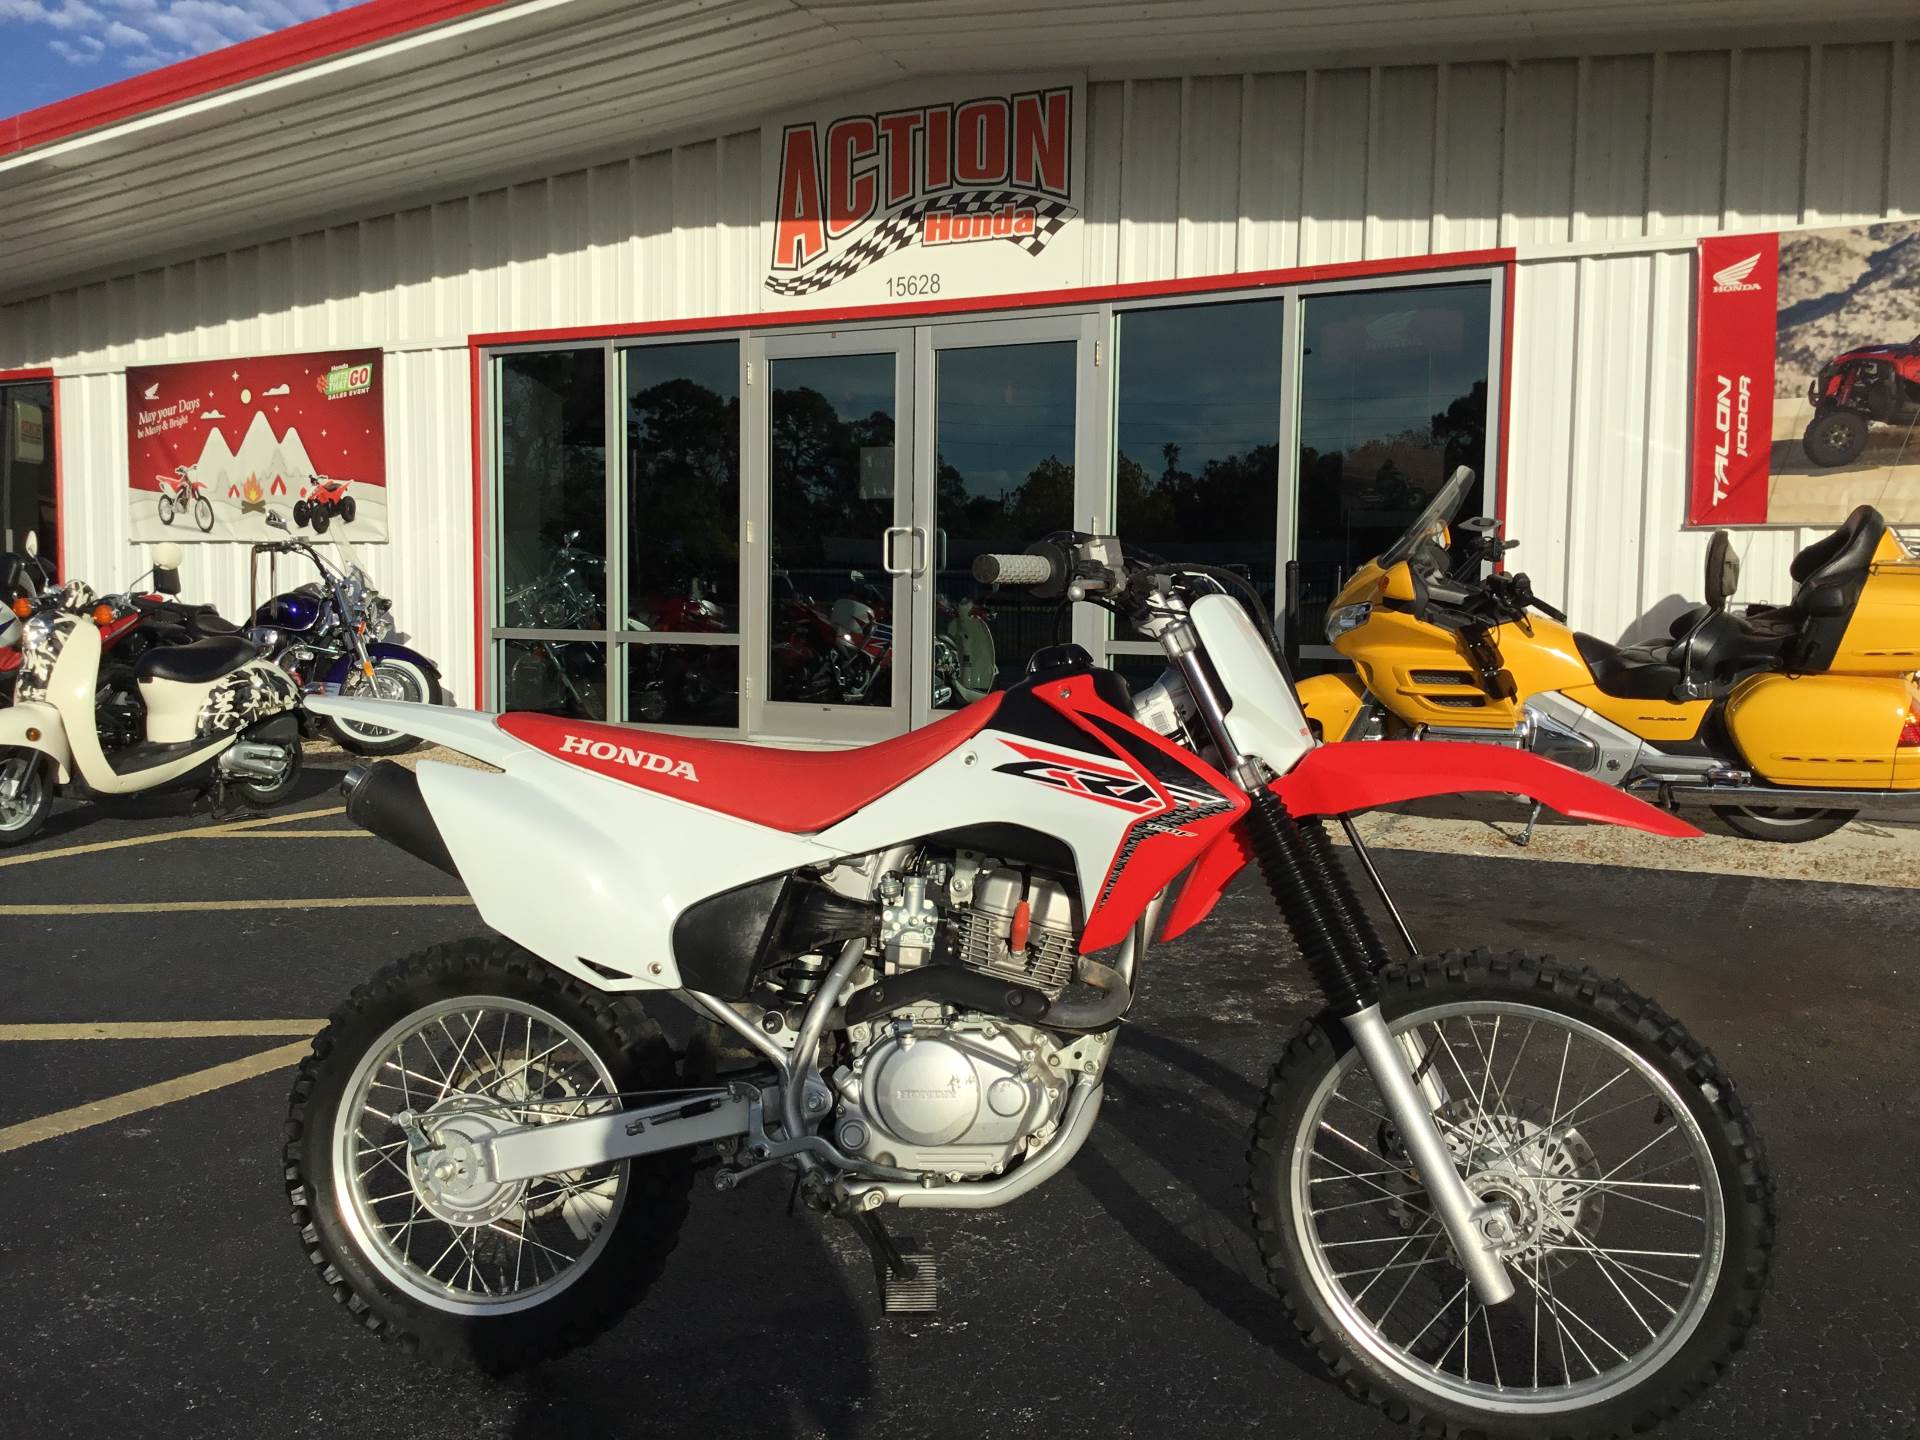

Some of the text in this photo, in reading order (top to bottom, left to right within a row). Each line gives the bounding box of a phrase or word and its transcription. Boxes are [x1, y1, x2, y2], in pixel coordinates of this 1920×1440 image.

[771, 86, 1073, 270] ACTION
[922, 202, 1036, 246] Honda
[886, 273, 941, 297] 15628
[1712, 283, 1762, 293] HONDA
[350, 367, 369, 386] GO
[328, 387, 370, 400] SALES EVENT
[139, 398, 200, 425] May your Days
[162, 420, 169, 431] &
[169, 415, 188, 429] Bright
[1736, 375, 1751, 457] 1000R
[1712, 375, 1732, 506] TALON
[559, 734, 699, 783] HONDA
